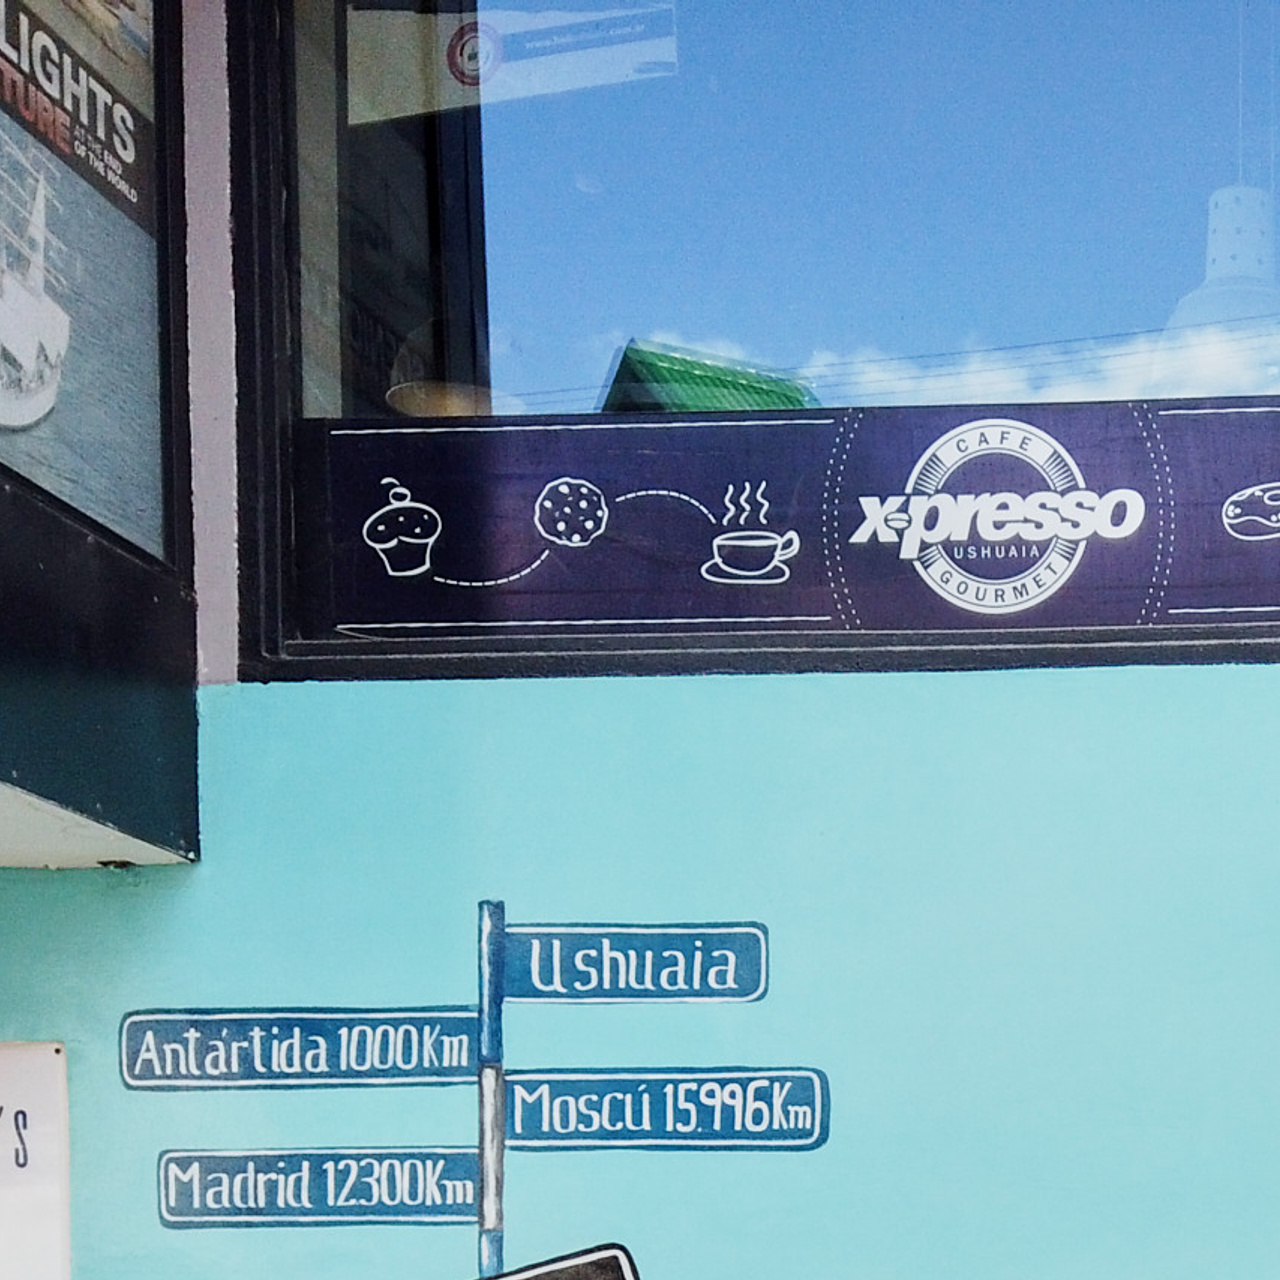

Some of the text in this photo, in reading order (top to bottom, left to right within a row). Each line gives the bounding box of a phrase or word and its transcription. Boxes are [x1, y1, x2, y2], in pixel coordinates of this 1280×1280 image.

[74, 140, 138, 203] OF THE WORLD
[103, 150, 122, 175] END
[956, 430, 1033, 453] CAFE
[954, 545, 1040, 560] USHUAIA
[939, 562, 1059, 603] GOURMET
[530, 938, 739, 993] Ushuaia
[134, 1026, 329, 1076] Antártida
[513, 1083, 651, 1134] Moscú
[168, 1160, 313, 1210] Madrid
